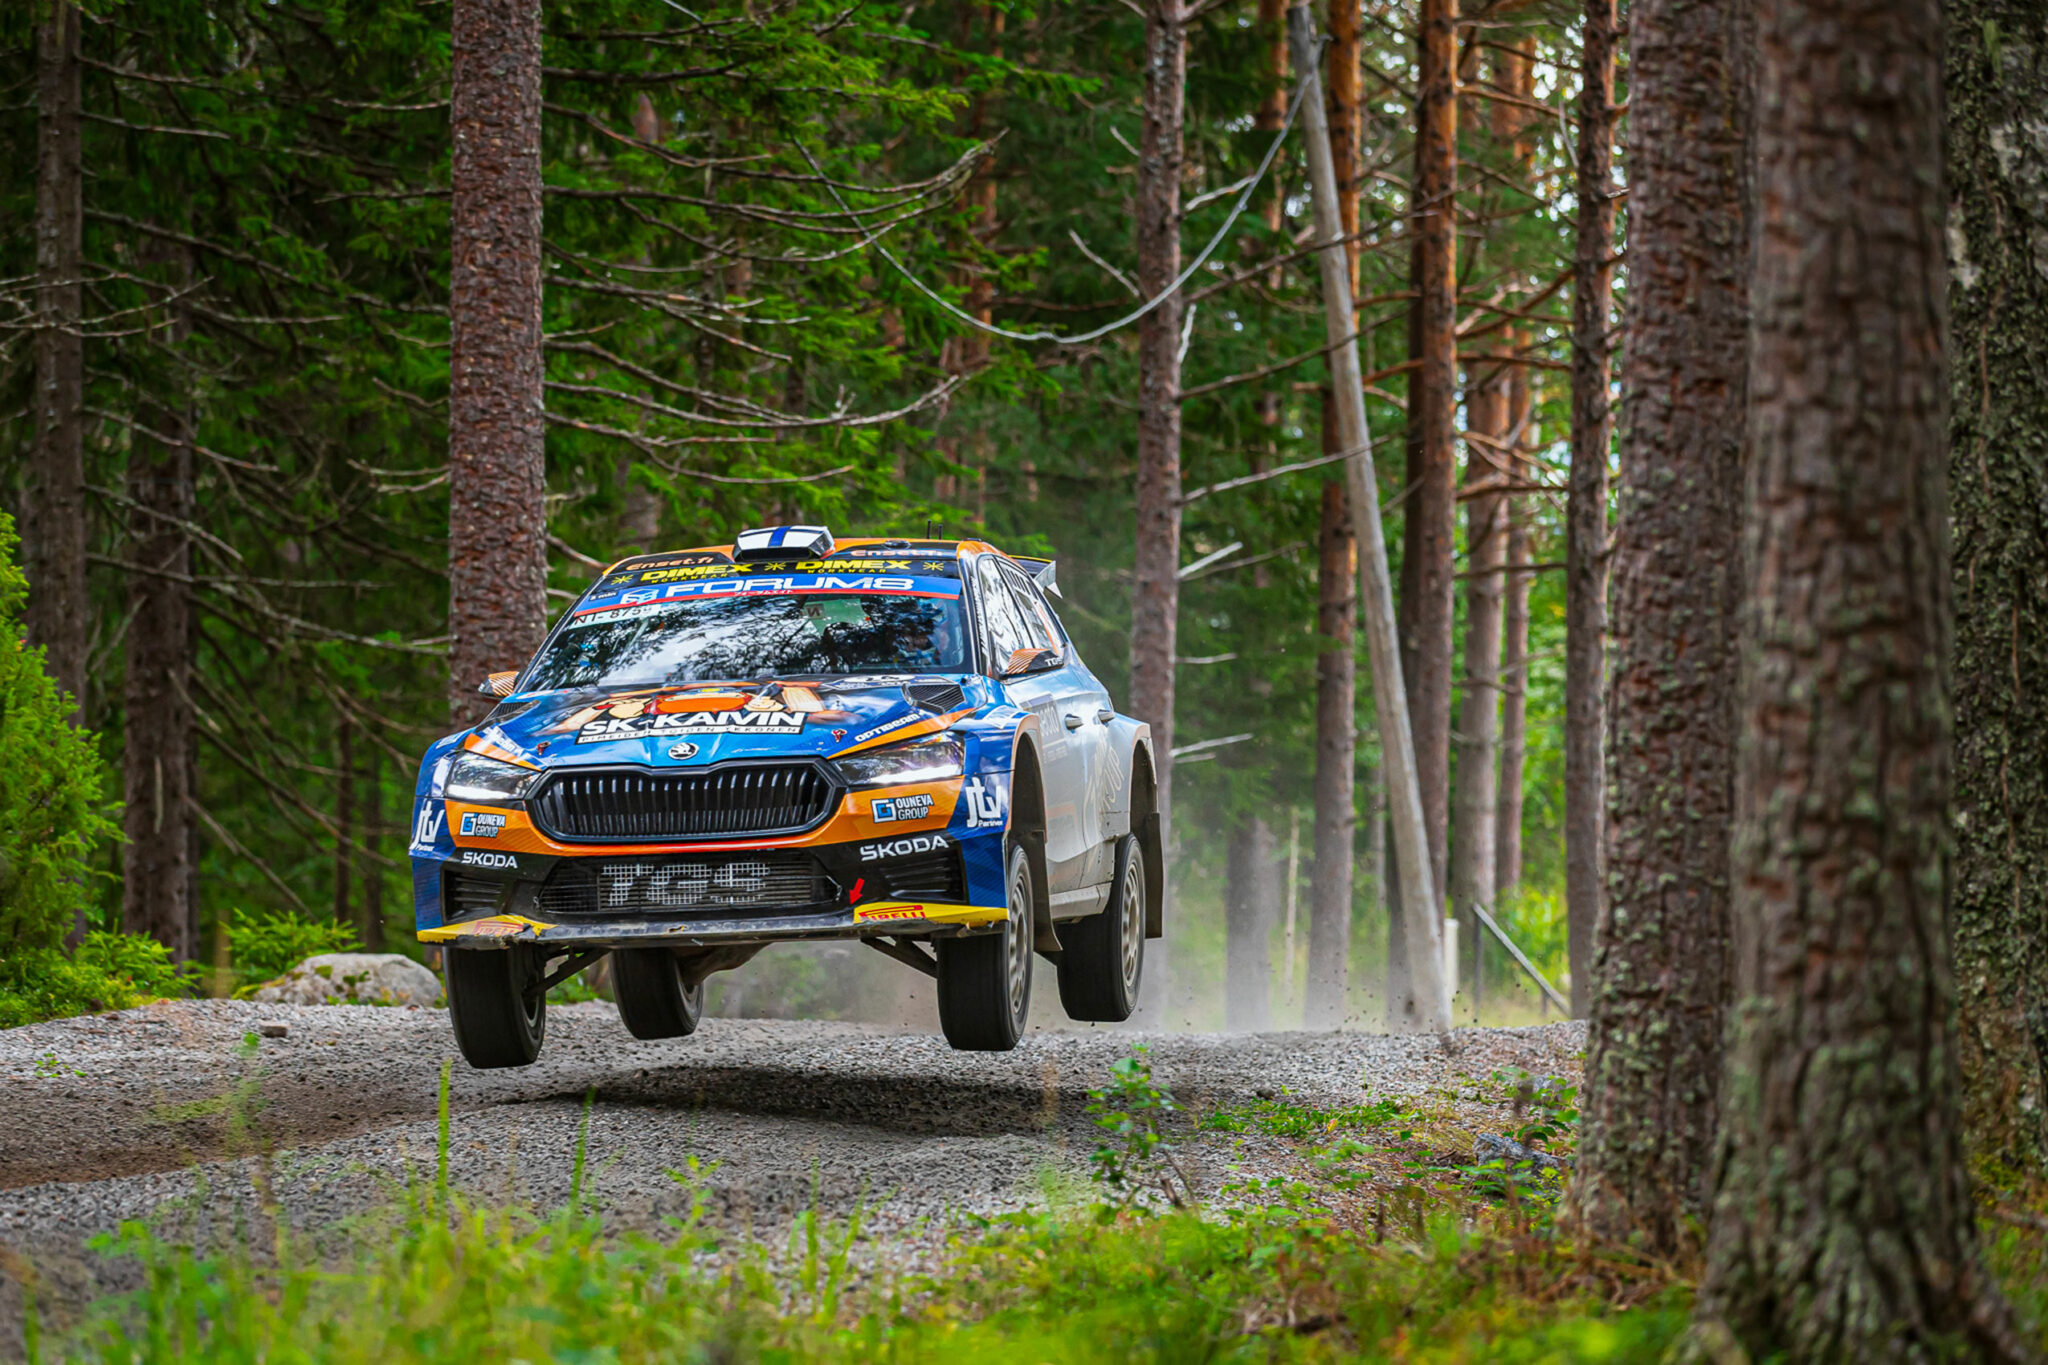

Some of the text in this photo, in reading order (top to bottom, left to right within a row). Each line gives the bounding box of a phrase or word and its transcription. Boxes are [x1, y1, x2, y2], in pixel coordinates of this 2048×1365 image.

[795, 560, 913, 570] DIMEX
[640, 563, 755, 582] DIMEX
[651, 573, 728, 584] WORKWEAR
[665, 576, 914, 598] FORUM8
[854, 713, 921, 743] OPTIBEAM
[895, 794, 934, 808] OUNEVA
[897, 806, 930, 820] GROUP
[477, 813, 506, 828] OUNEVA
[978, 819, 1004, 828] Partner
[475, 824, 499, 837] GROUP
[601, 862, 770, 907] TGS
